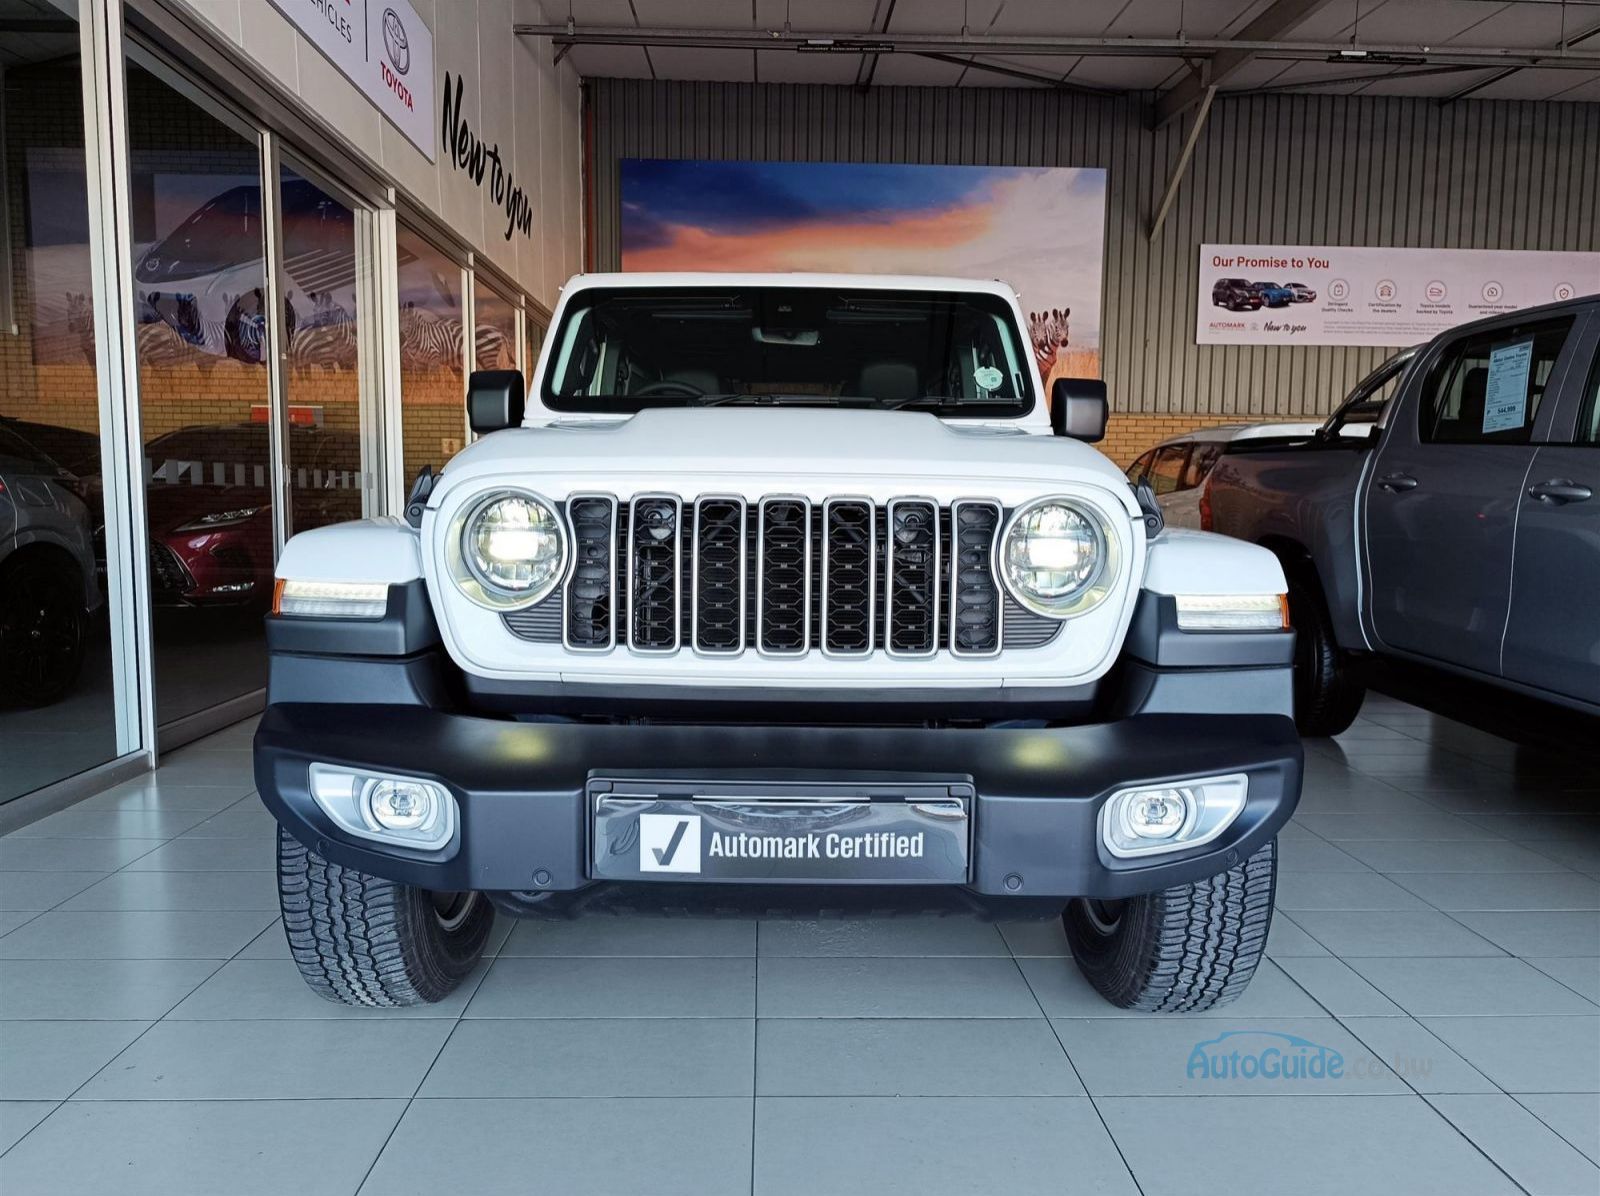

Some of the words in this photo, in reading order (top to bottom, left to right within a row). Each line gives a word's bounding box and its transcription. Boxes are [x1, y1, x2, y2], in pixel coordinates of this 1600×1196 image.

[380, 61, 414, 112] TOYOTA
[442, 70, 486, 187] New
[486, 144, 505, 206] to
[504, 172, 533, 241] you
[1212, 255, 1234, 267] Our
[1236, 256, 1288, 268] Promise
[1291, 258, 1304, 269] to
[1307, 257, 1330, 269] You
[1263, 320, 1281, 332] New
[1283, 323, 1290, 331] to
[1290, 325, 1307, 335] you
[709, 831, 820, 859] Automark
[826, 832, 924, 858] Certified
